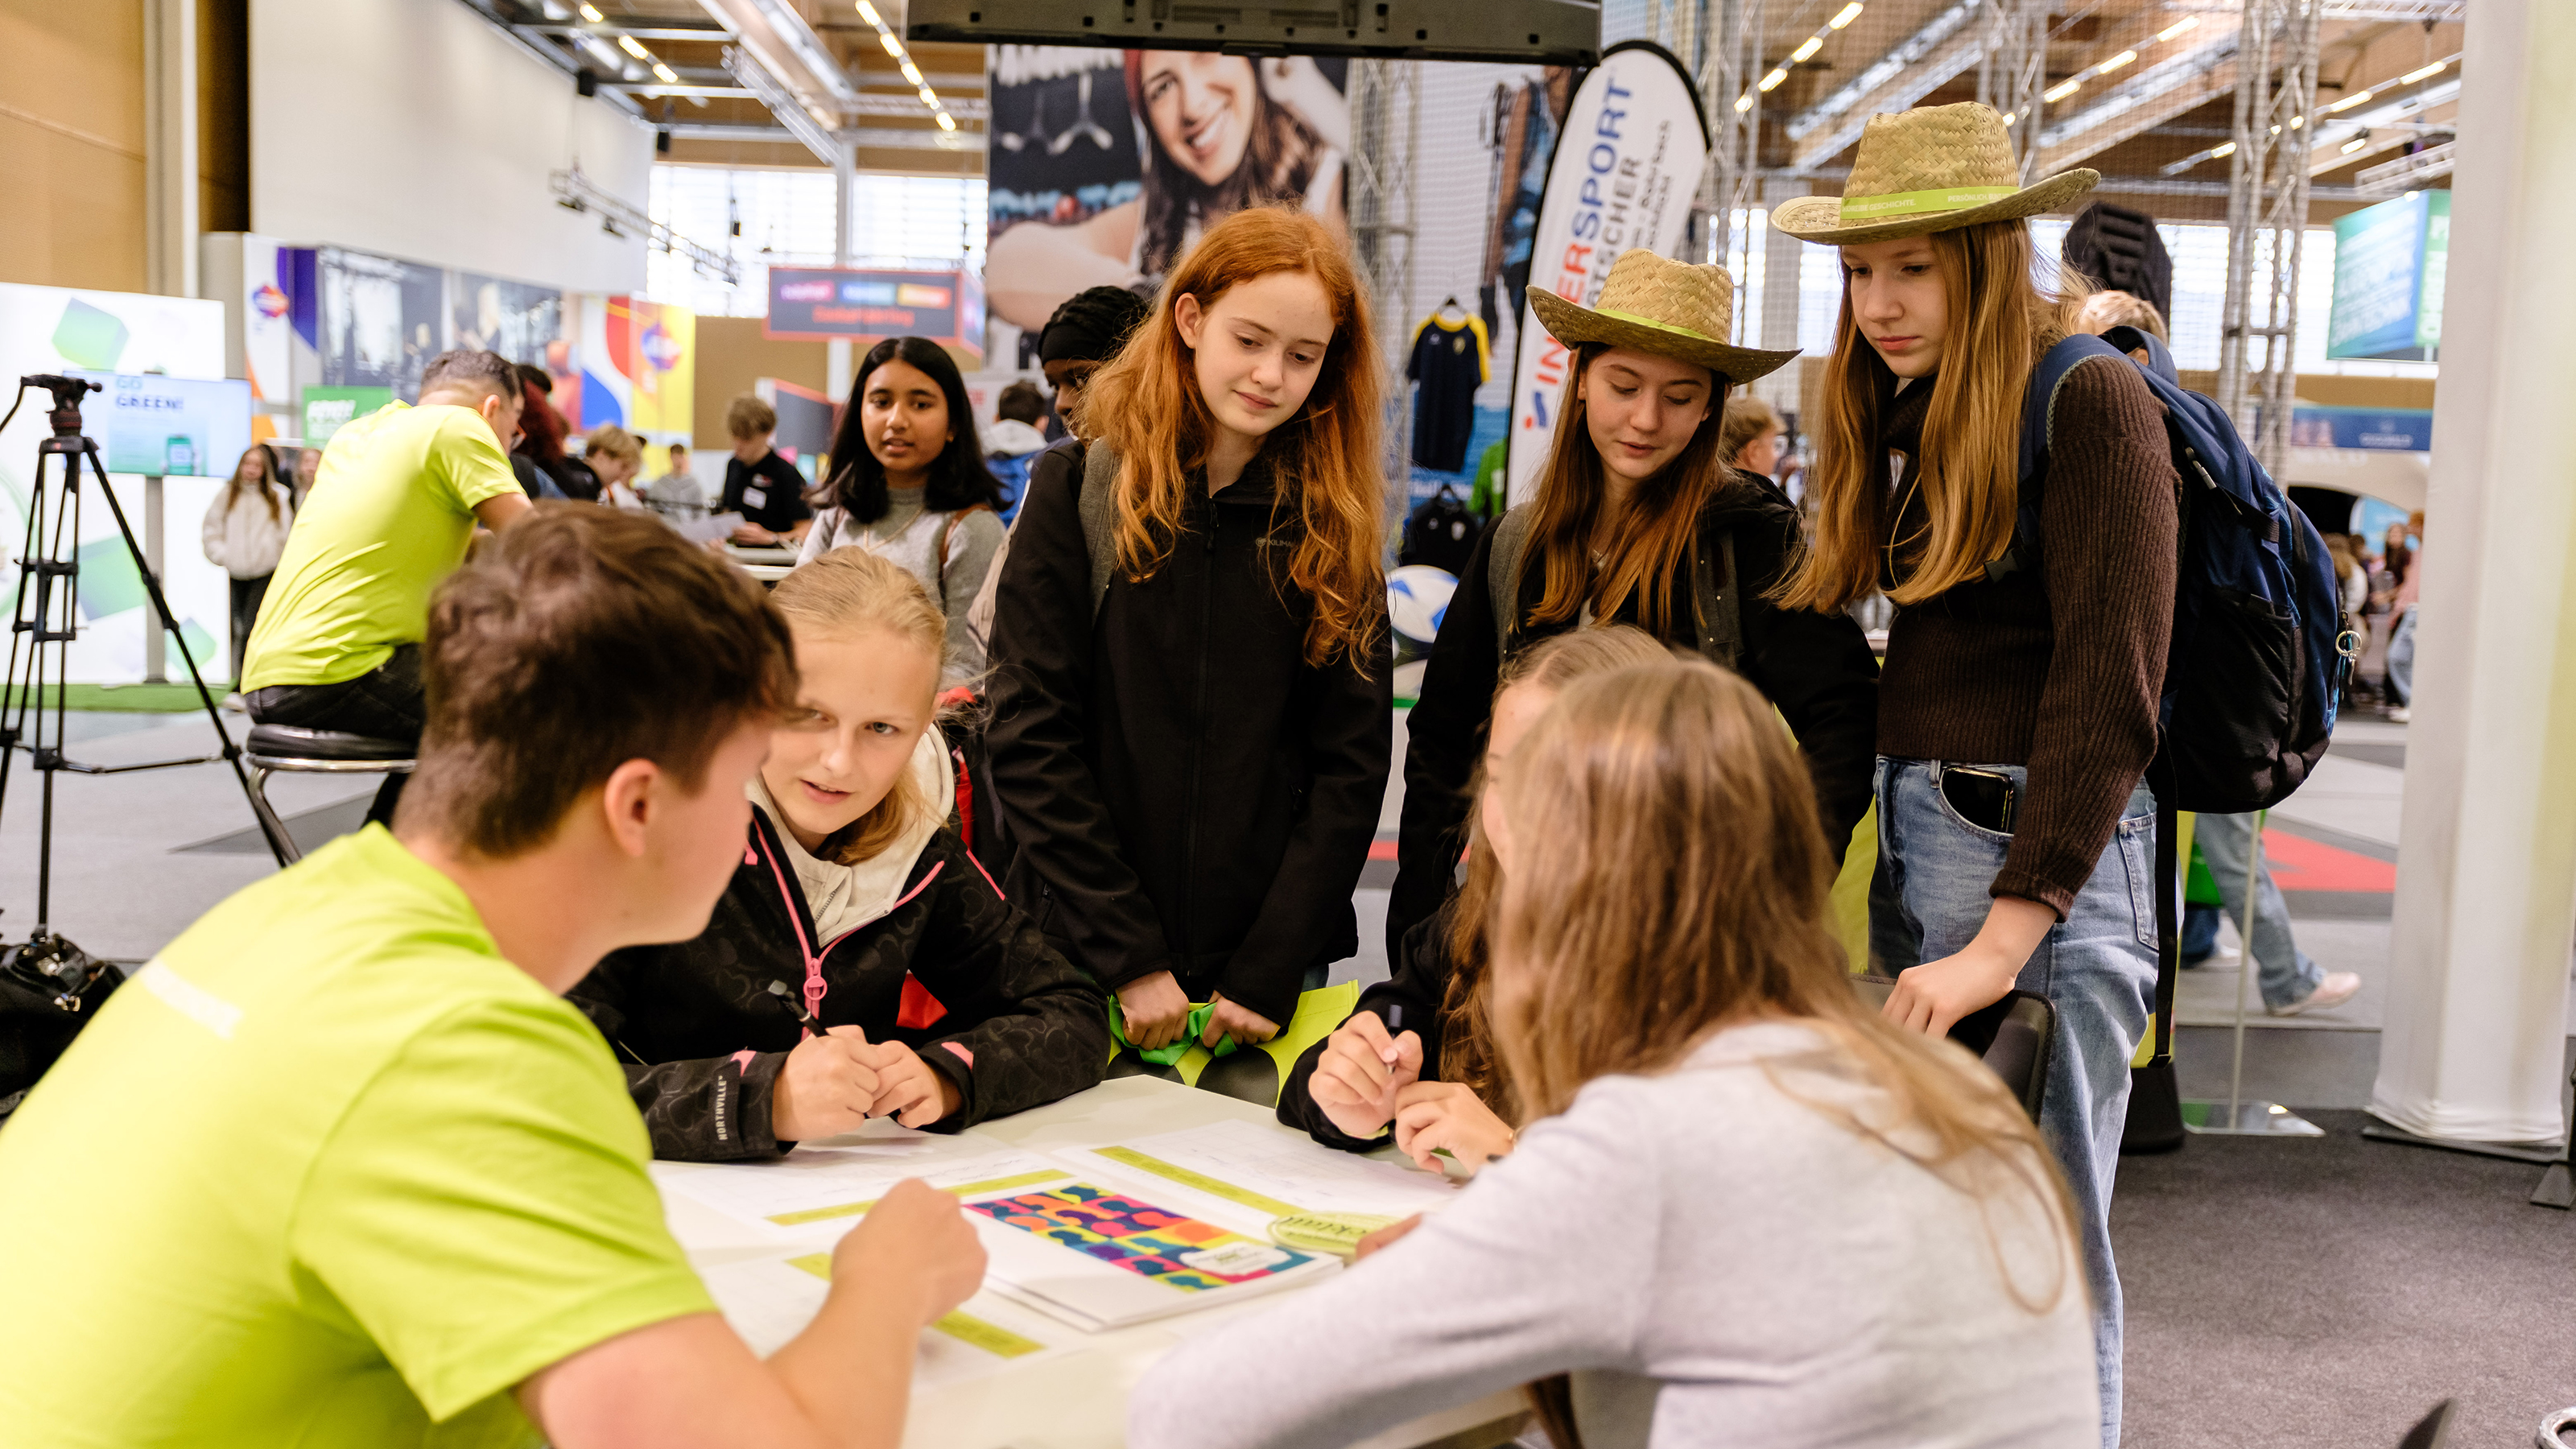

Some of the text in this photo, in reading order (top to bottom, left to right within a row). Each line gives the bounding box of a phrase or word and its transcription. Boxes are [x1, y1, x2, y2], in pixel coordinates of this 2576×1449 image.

[1534, 74, 1633, 385] INERSPORT
[1583, 155, 1644, 308] ÖTSCHER
[1868, 198, 1917, 212] GESCHICHTE.
[1269, 539, 1292, 547] KILIMA
[714, 1080, 729, 1141] NORTHVILLE
